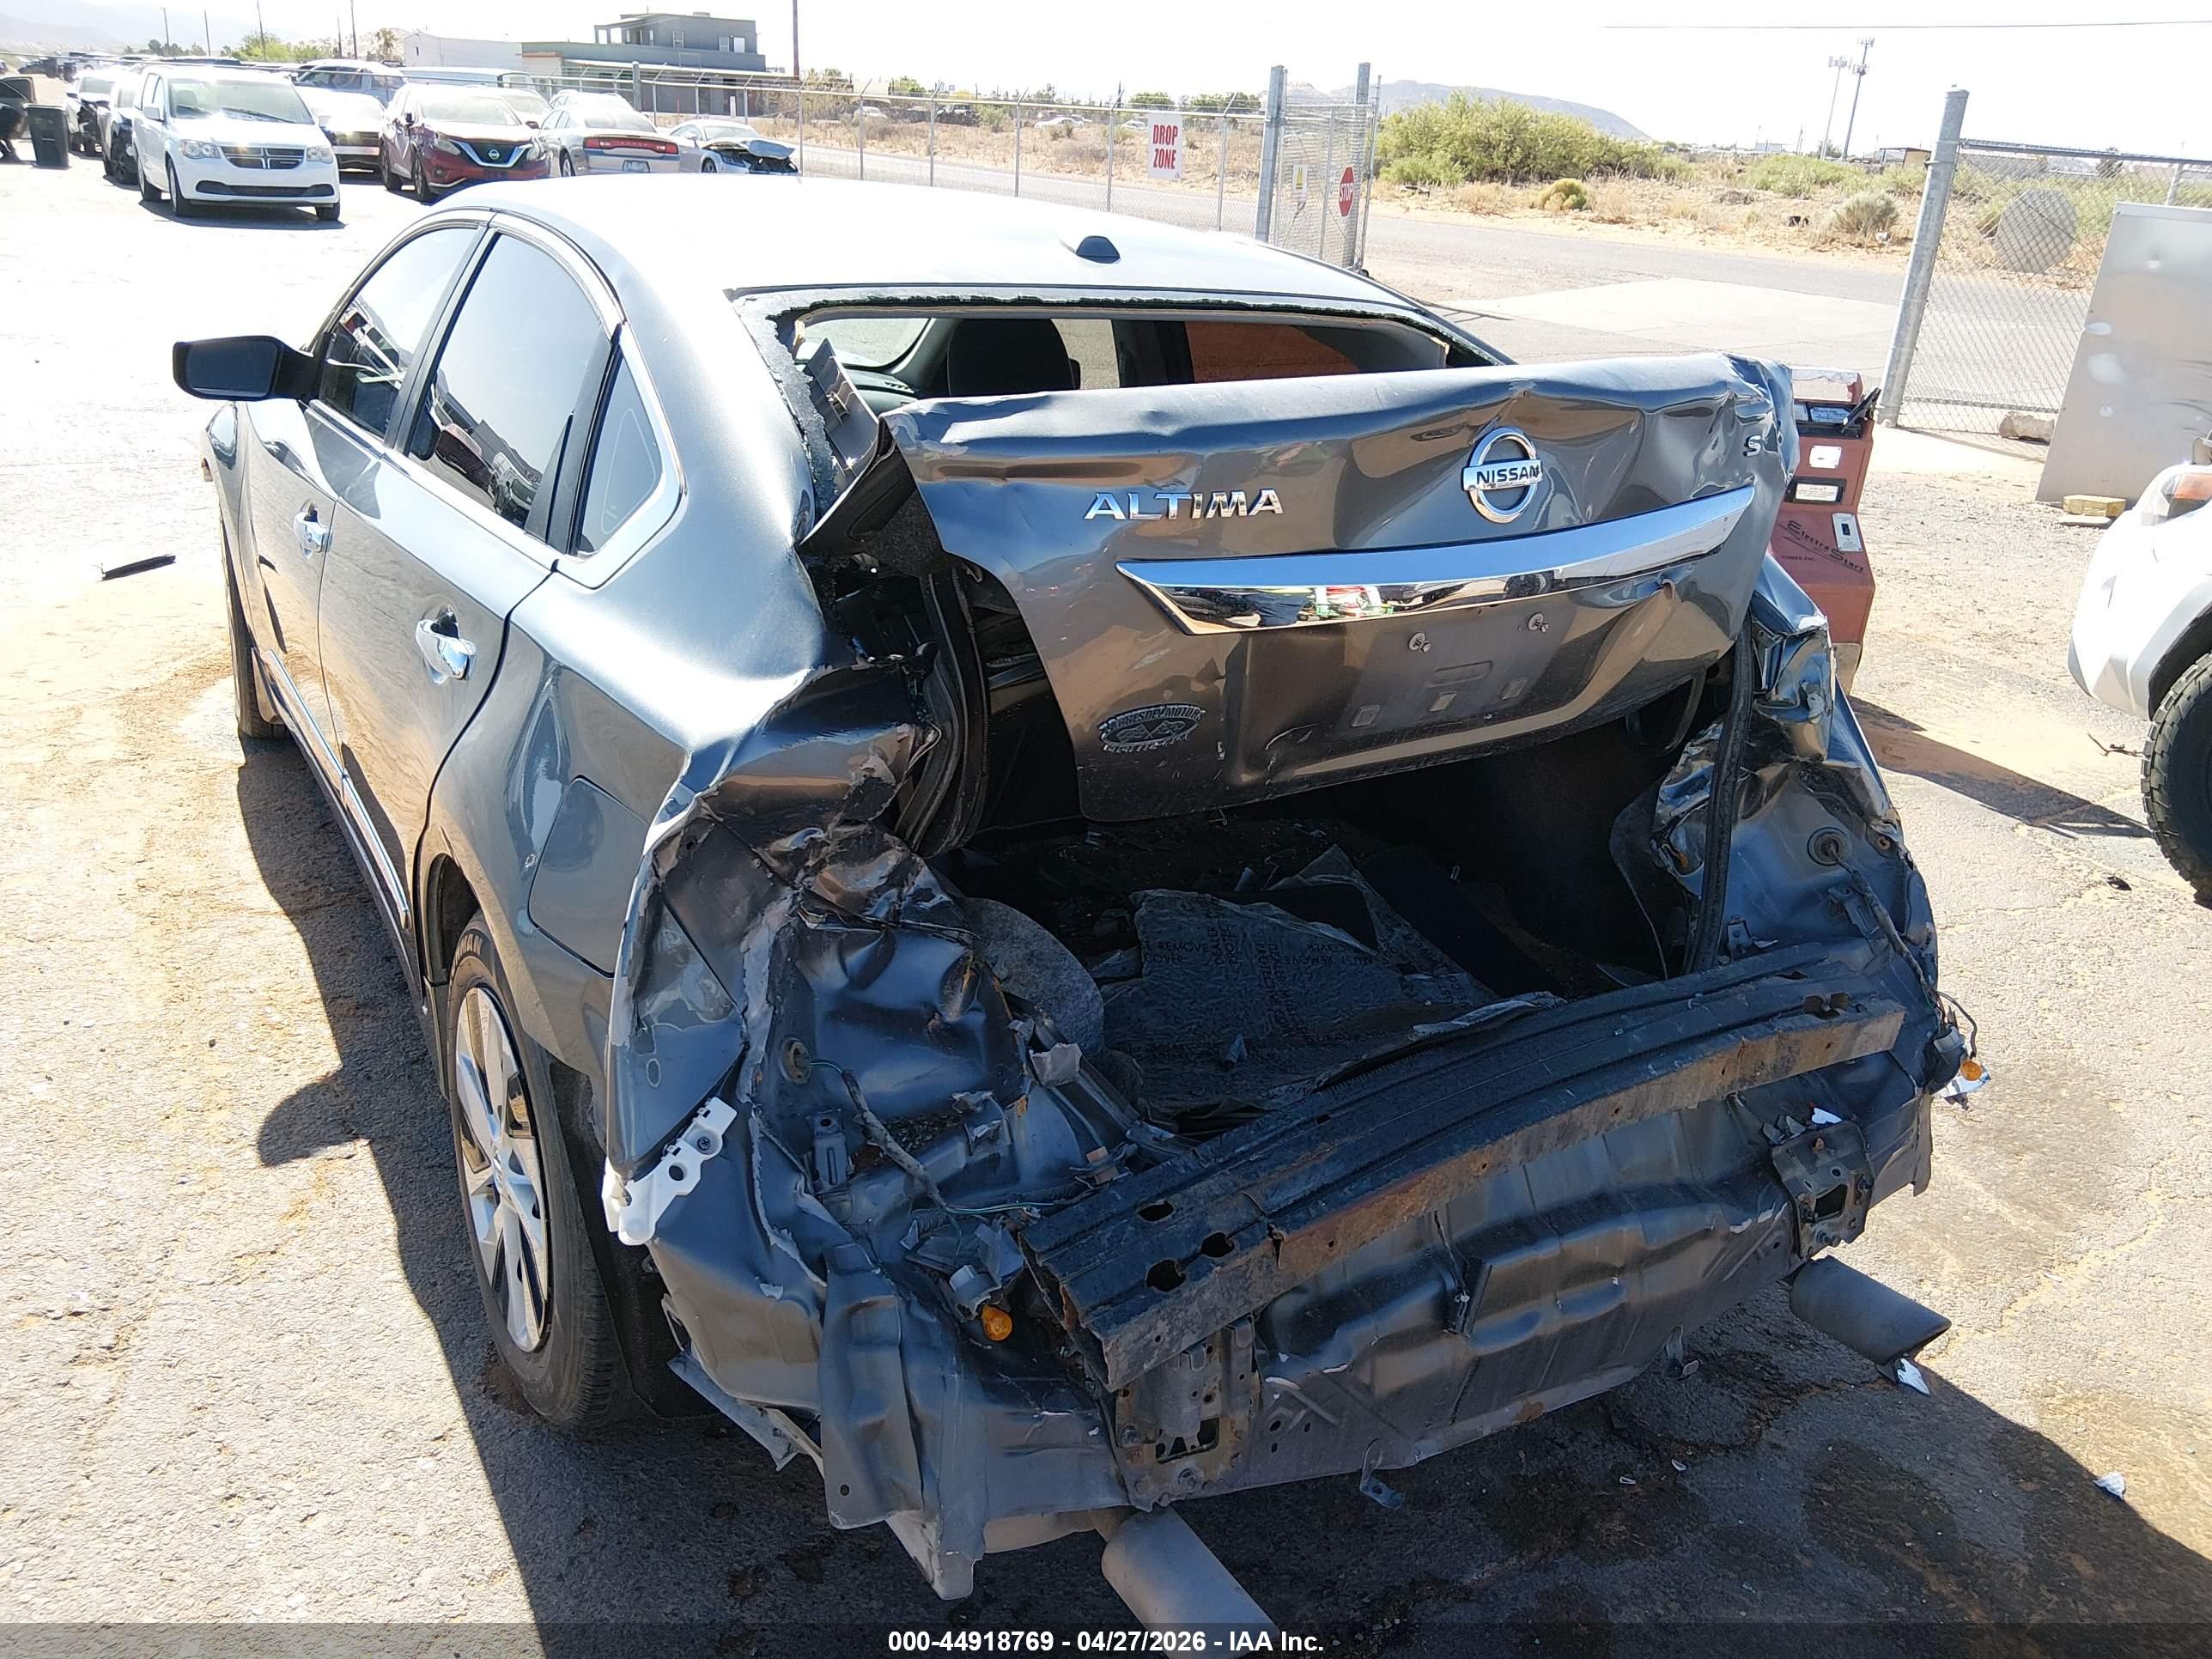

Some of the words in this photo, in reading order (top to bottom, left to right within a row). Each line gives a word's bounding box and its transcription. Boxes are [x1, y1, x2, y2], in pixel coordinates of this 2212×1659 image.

[1152, 125, 1178, 146] DROP
[1153, 149, 1176, 169] ZONE
[1340, 183, 1354, 202] STOP
[1476, 465, 1540, 485] NISSAN
[1084, 489, 1284, 520] ALTIMA
[1158, 941, 1209, 952] REMOVE
